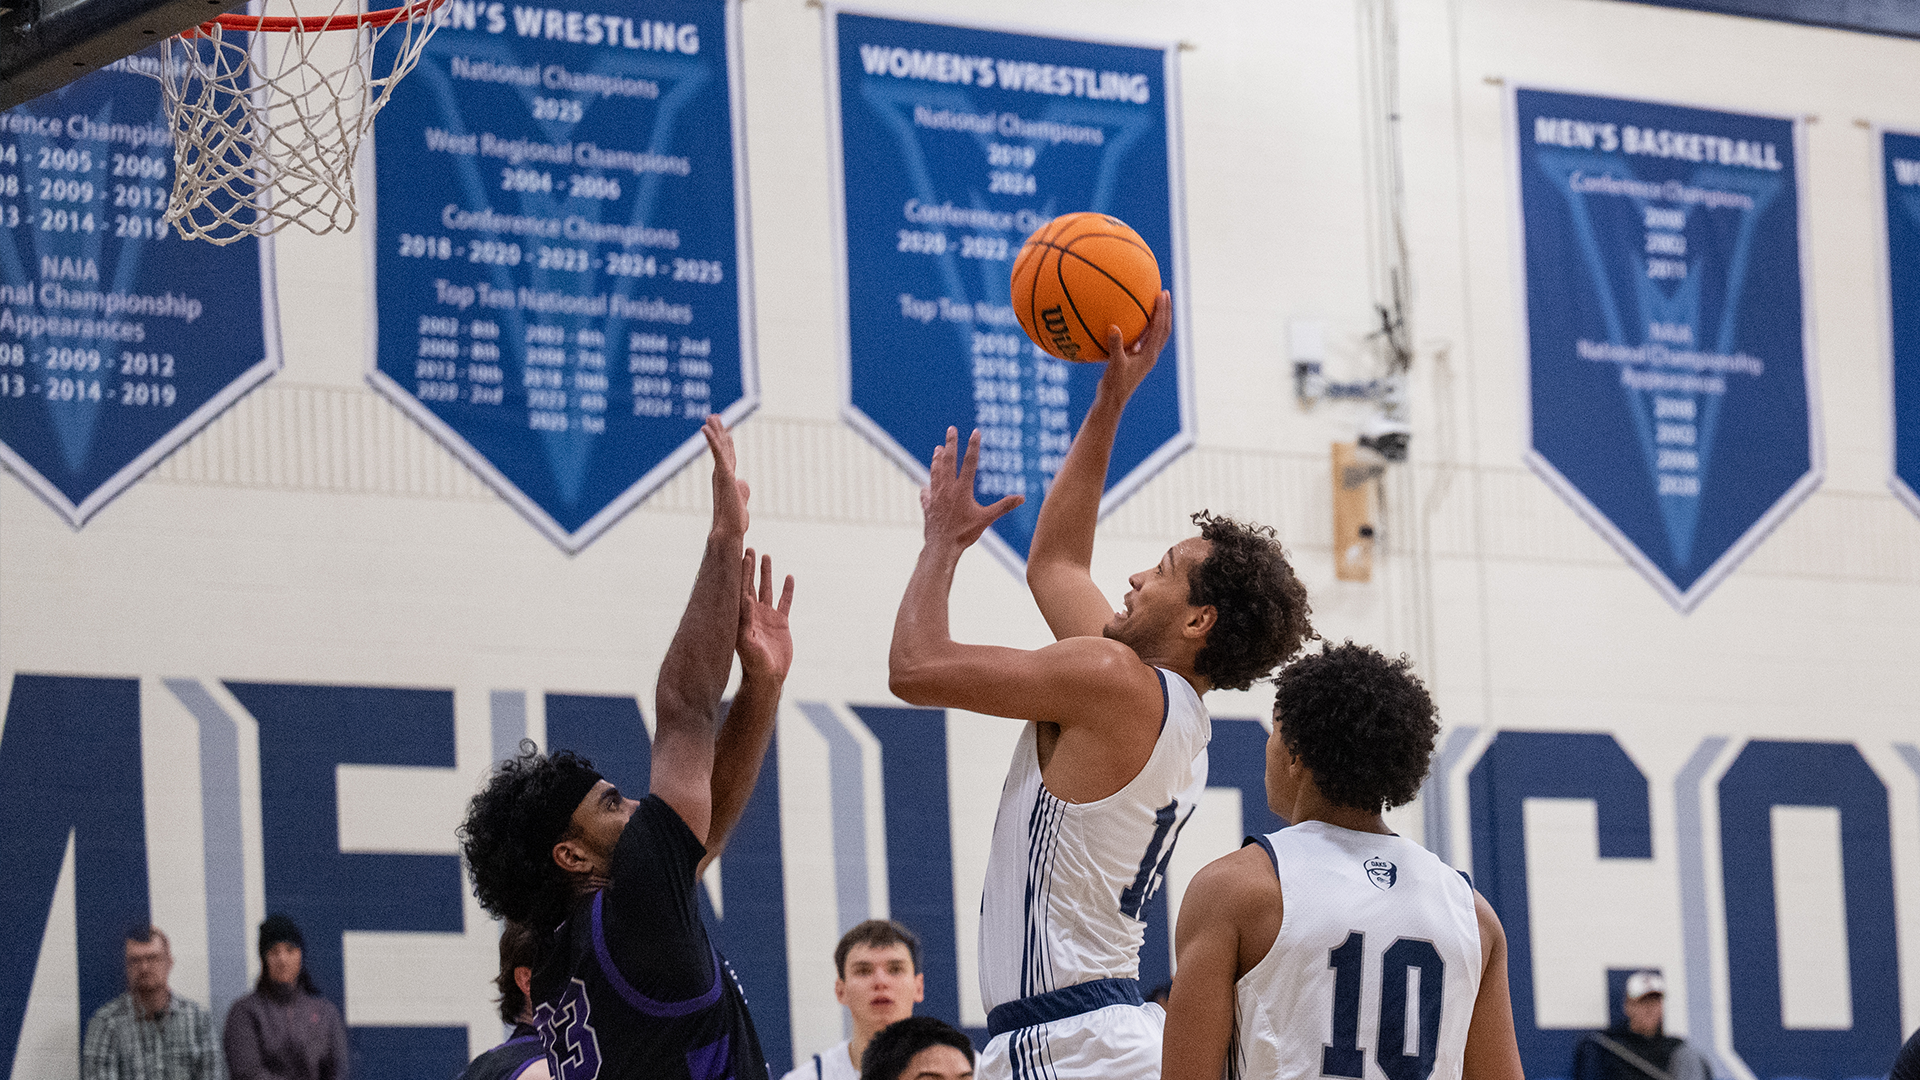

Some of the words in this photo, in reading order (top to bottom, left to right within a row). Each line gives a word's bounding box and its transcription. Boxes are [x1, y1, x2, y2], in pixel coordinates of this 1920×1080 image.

[513, 7, 700, 54] WRESTLING
[451, 56, 541, 86] National
[542, 65, 659, 99] Champions
[859, 43, 996, 88] WOMEN'S
[999, 59, 1150, 105] WRESTLING
[67, 114, 175, 149] Champio
[914, 105, 997, 134] National
[999, 111, 1104, 147] Champions
[1534, 116, 1619, 152] MEN'S
[1621, 125, 1783, 171] BASKETBALL
[38, 146, 93, 174] 2005
[113, 153, 168, 180] 2006
[425, 127, 478, 155] West
[480, 133, 573, 164] Regional
[574, 142, 691, 177] Champions
[40, 177, 94, 204] 2009
[113, 183, 168, 211] 2012
[1569, 170, 1661, 199] Conference
[1661, 179, 1754, 211] Champions
[40, 208, 96, 235] 2014
[442, 204, 562, 237] Conference
[563, 215, 680, 250] Champions
[903, 198, 1013, 231] Conference
[40, 255, 99, 282] NAIA
[39, 282, 203, 324] Championship
[435, 278, 475, 311] Top
[477, 282, 516, 309] Ten
[518, 286, 607, 316] National
[610, 293, 693, 325] Finishes
[900, 293, 938, 324] Top
[939, 296, 974, 323] Ten
[0, 307, 146, 343] Appearances
[46, 346, 100, 372] 2009
[121, 351, 175, 377] 2012
[47, 376, 101, 403] 2014
[121, 381, 177, 407] 2019
[1319, 929, 1446, 1080] 10
